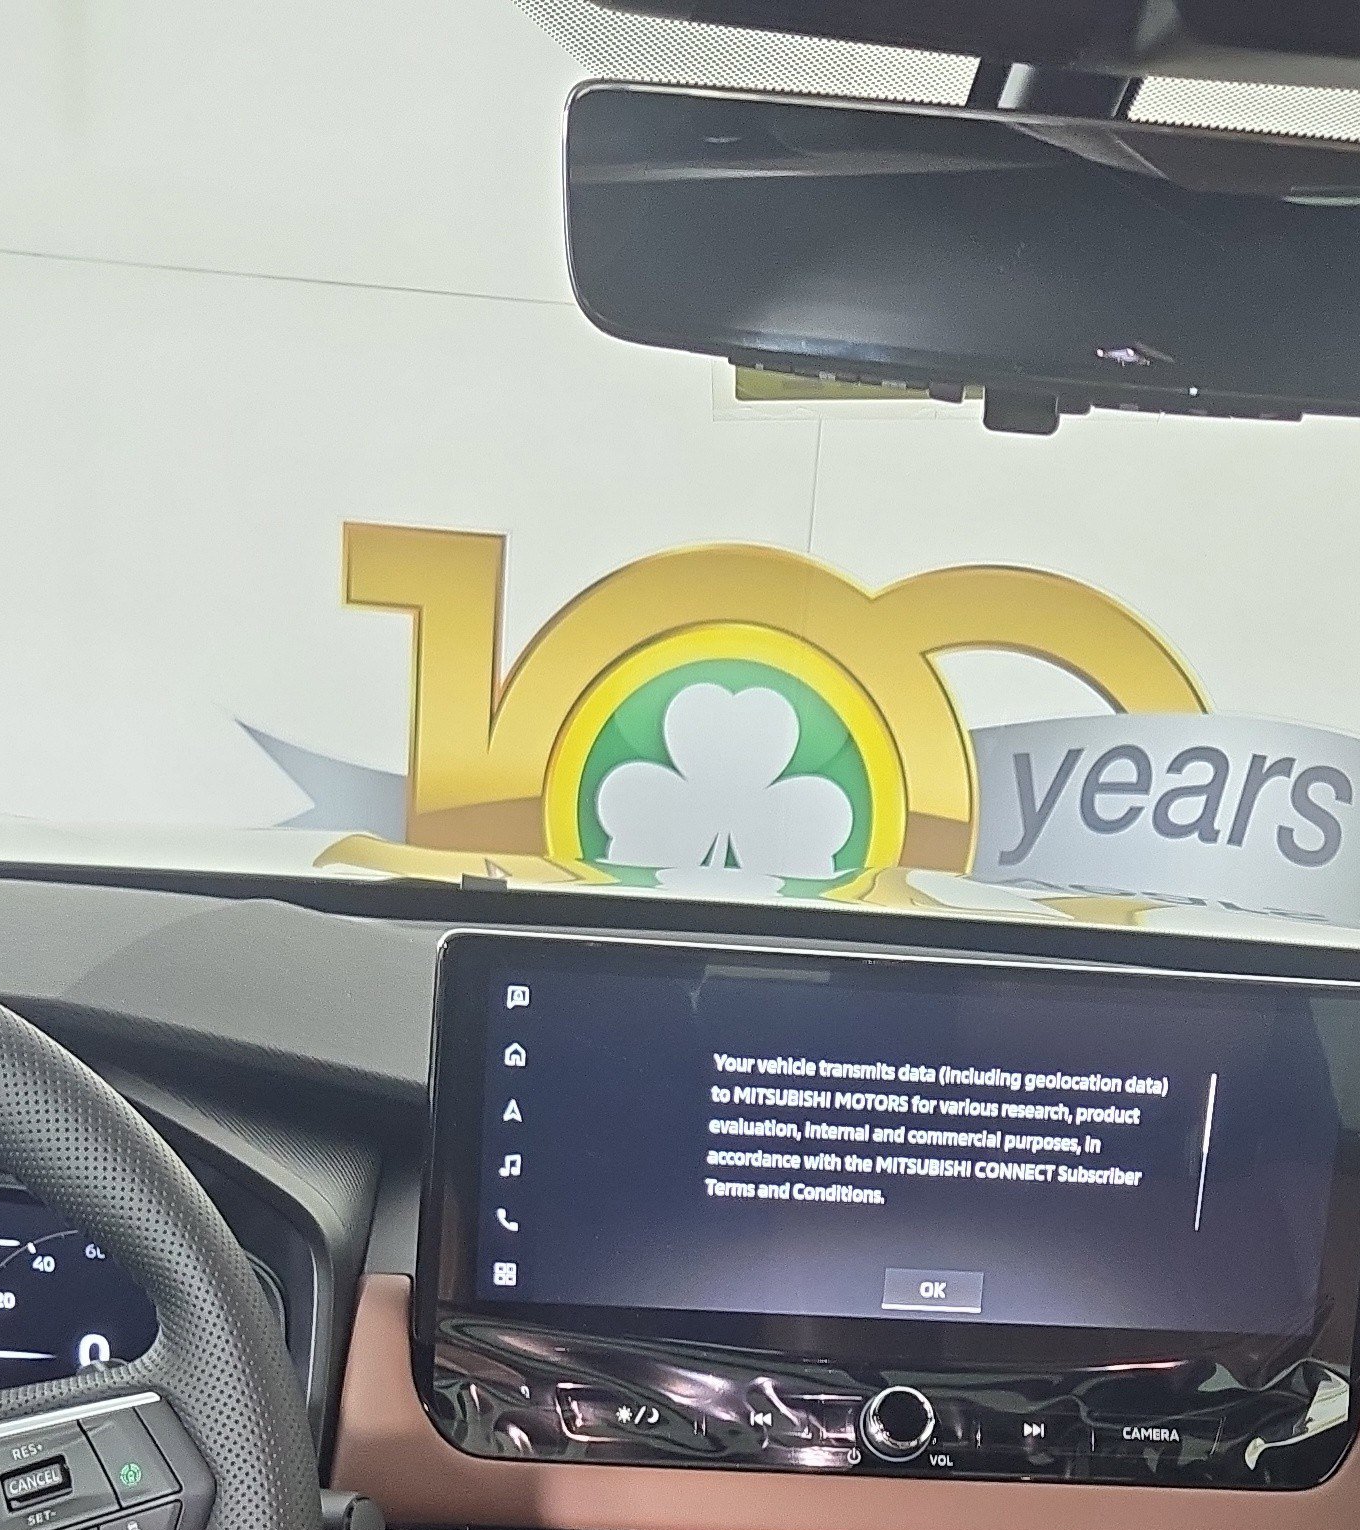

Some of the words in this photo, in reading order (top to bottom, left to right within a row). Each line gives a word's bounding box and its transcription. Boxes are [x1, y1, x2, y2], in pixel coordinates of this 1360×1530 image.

[998, 743, 1353, 867] years
[713, 1053, 755, 1073] Your
[757, 1056, 816, 1077] vehicle
[819, 1060, 895, 1081] transmits
[898, 1064, 936, 1083] data
[939, 1066, 1021, 1091] (including
[1024, 1069, 1122, 1094] geolocation
[1125, 1075, 1169, 1097] data)
[711, 1086, 730, 1103] to
[734, 1086, 830, 1110] MITSUBISHI
[835, 1092, 908, 1113] MOTORS
[912, 1096, 938, 1114] for
[940, 1099, 998, 1118] various
[1001, 1102, 1072, 1123] research,
[1076, 1105, 1140, 1126] product
[709, 1117, 802, 1141] evaluation,
[805, 1121, 869, 1143] internal
[873, 1125, 904, 1144] and
[907, 1127, 1000, 1149] commercial
[1004, 1133, 1081, 1155] purposes,
[1085, 1136, 1101, 1153] in
[707, 1149, 801, 1170] accordance
[803, 1153, 841, 1172] with
[845, 1156, 873, 1173] the
[876, 1156, 971, 1179] MITSUBISHI
[975, 1162, 1054, 1183] CONNECT
[1058, 1165, 1142, 1187] Subscriber
[705, 1178, 755, 1197] Terms
[757, 1181, 790, 1199] and
[793, 1183, 885, 1205] Conditions.
[32, 1255, 55, 1273] 40
[919, 1281, 946, 1299] OK
[78, 1333, 110, 1366] 0
[1122, 1427, 1179, 1442] CAMERA
[929, 1454, 953, 1466] VOL
[9, 1470, 60, 1494] CANCEL
